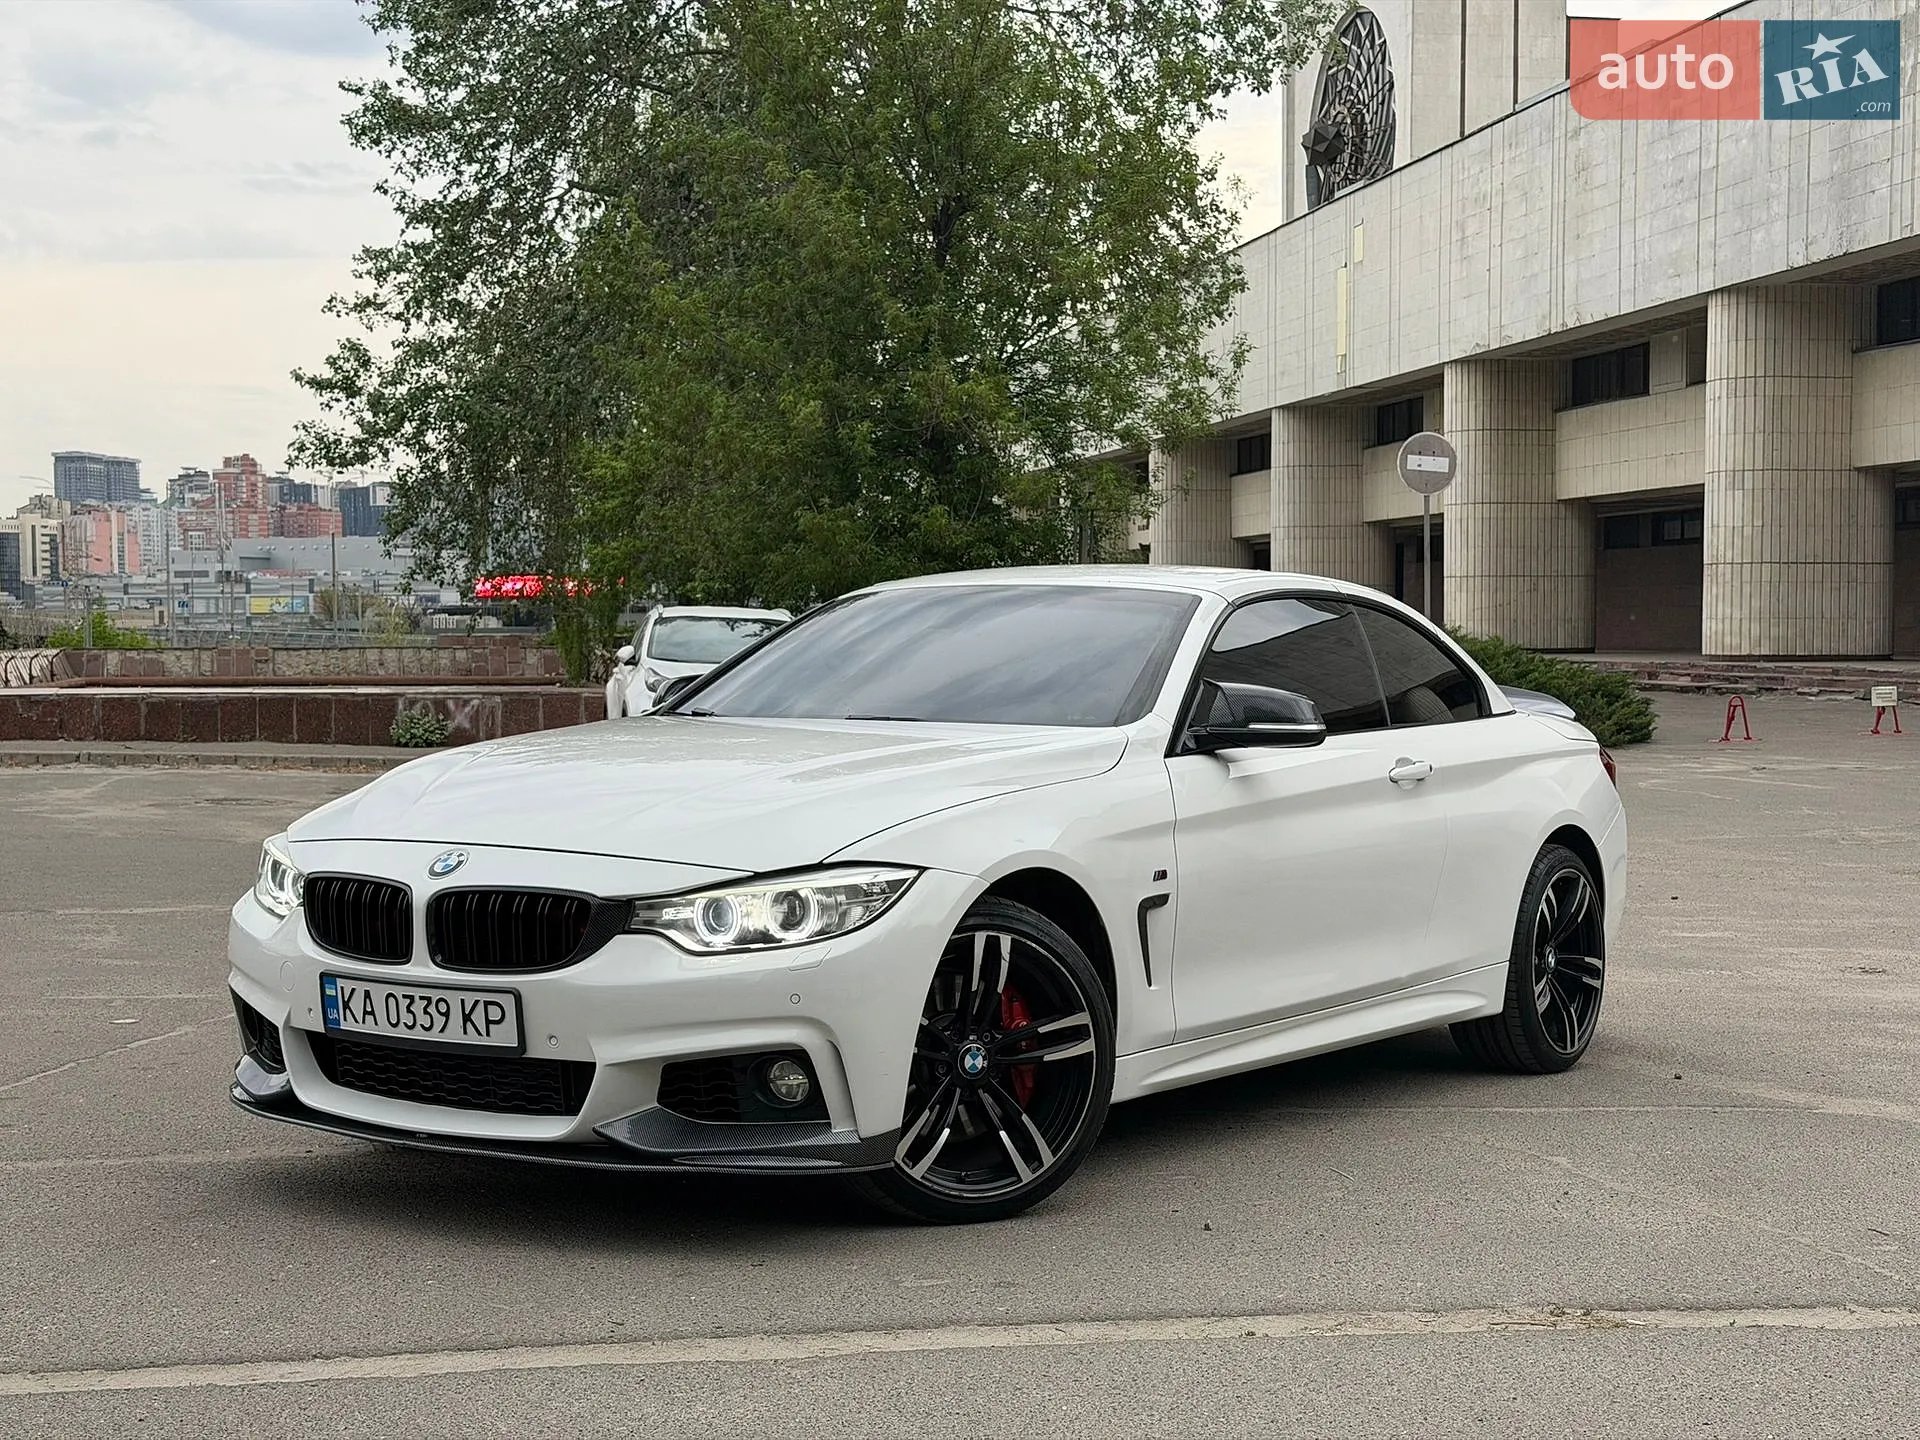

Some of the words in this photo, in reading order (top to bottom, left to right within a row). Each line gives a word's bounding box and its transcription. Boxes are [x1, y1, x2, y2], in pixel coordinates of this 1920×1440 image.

[327, 1008, 339, 1019] UA
[340, 985, 379, 1026] KA
[384, 992, 451, 1034] 0339
[460, 998, 506, 1038] KP
